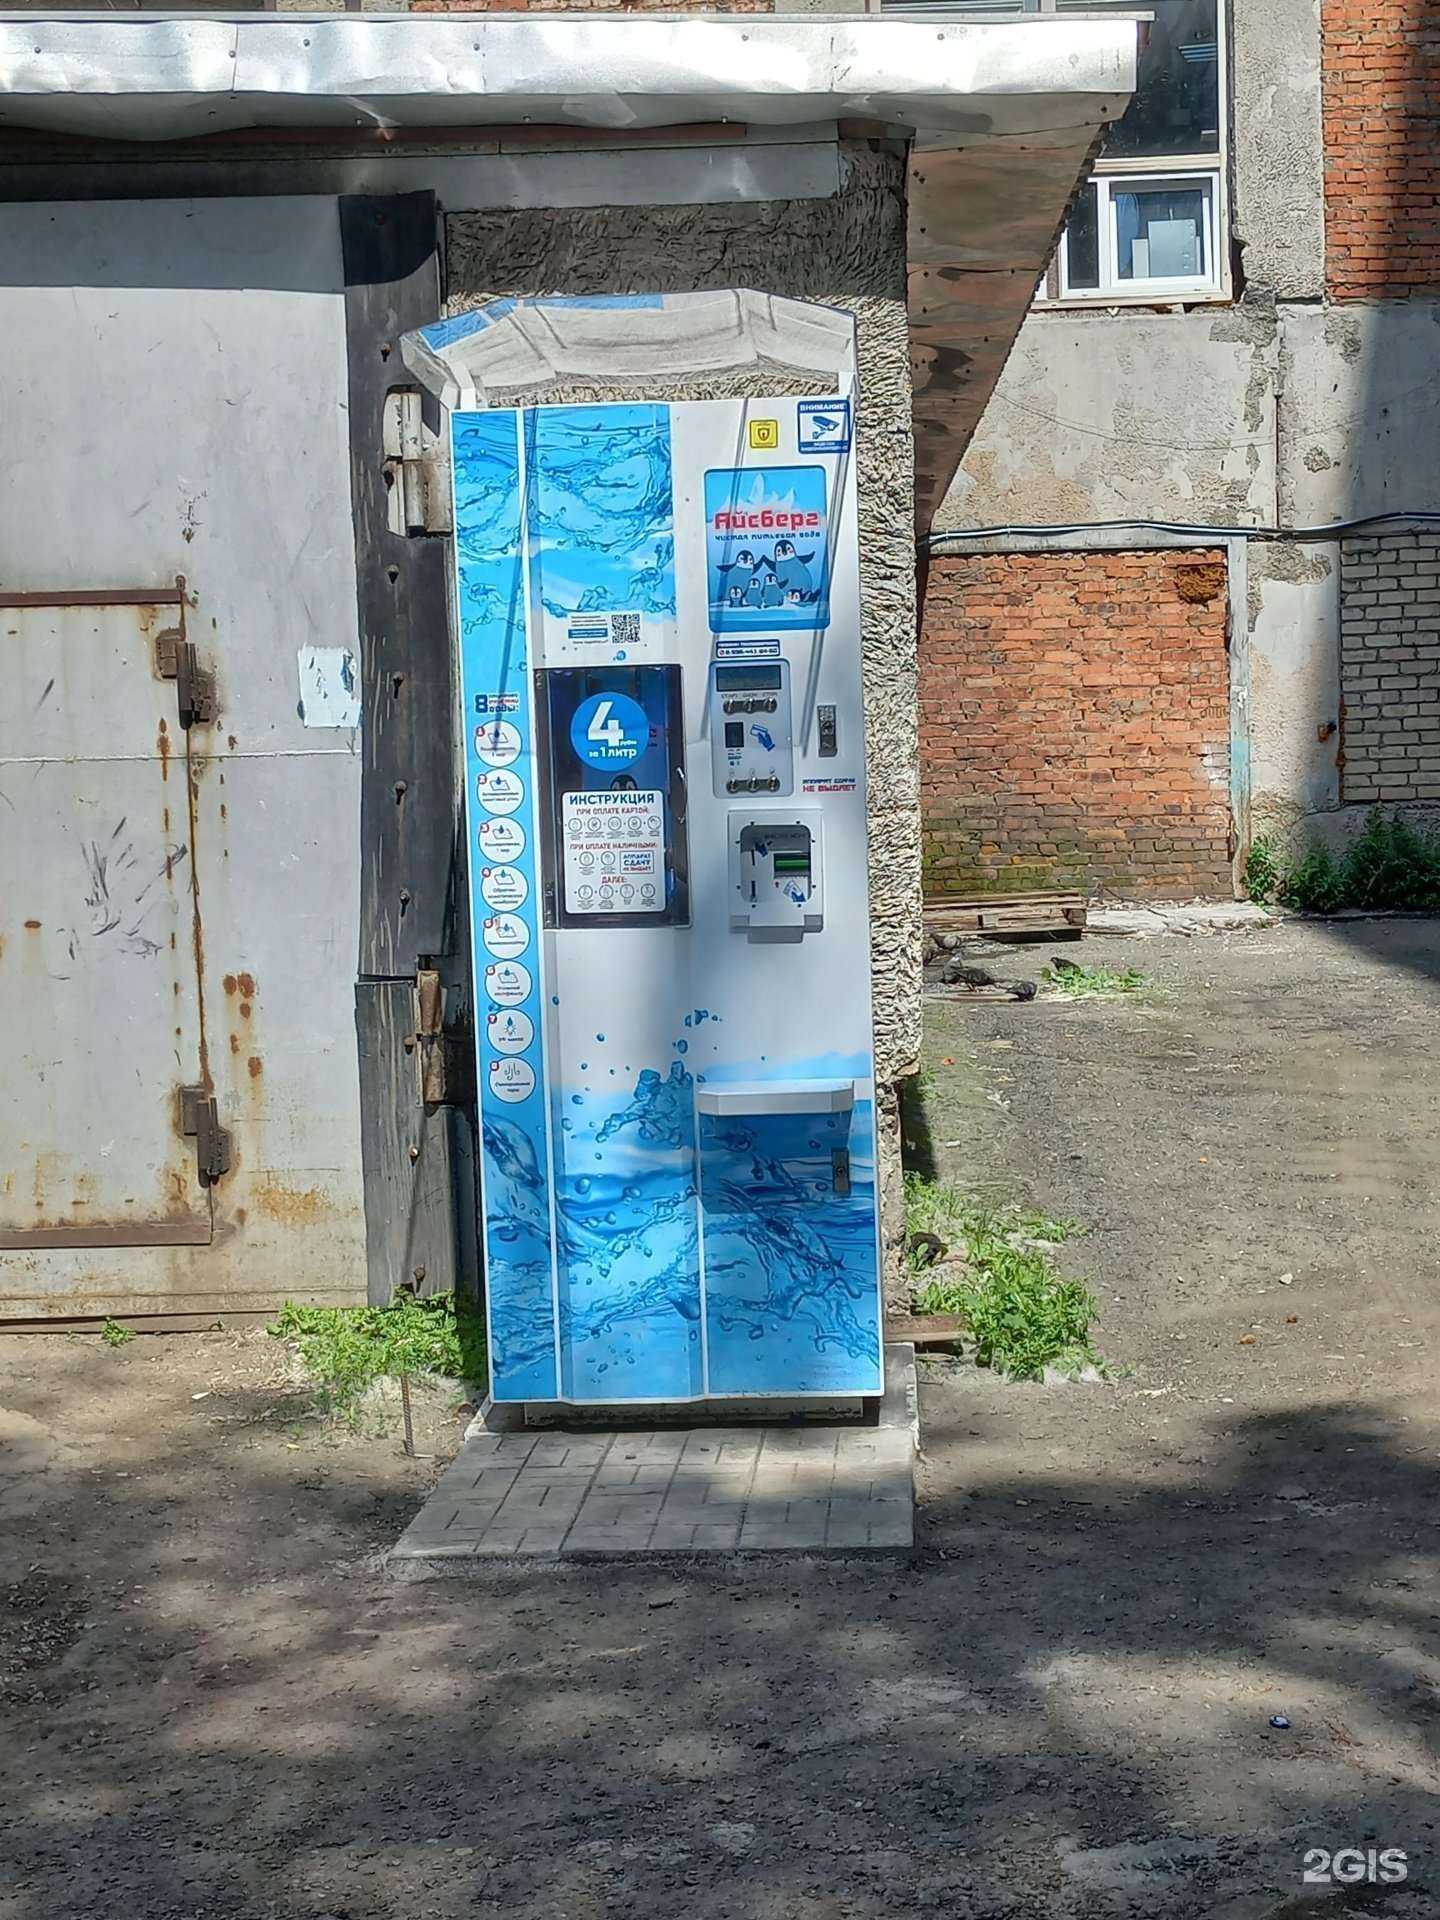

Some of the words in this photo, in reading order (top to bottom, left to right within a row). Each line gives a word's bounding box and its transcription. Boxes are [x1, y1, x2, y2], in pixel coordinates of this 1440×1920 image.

[714, 510, 819, 530] Айсберг
[475, 694, 488, 713] 8
[588, 701, 624, 747] 4
[600, 747, 606, 758] 1
[608, 748, 637, 760] литр
[569, 793, 655, 805] ИНСТРУКЦИЯ
